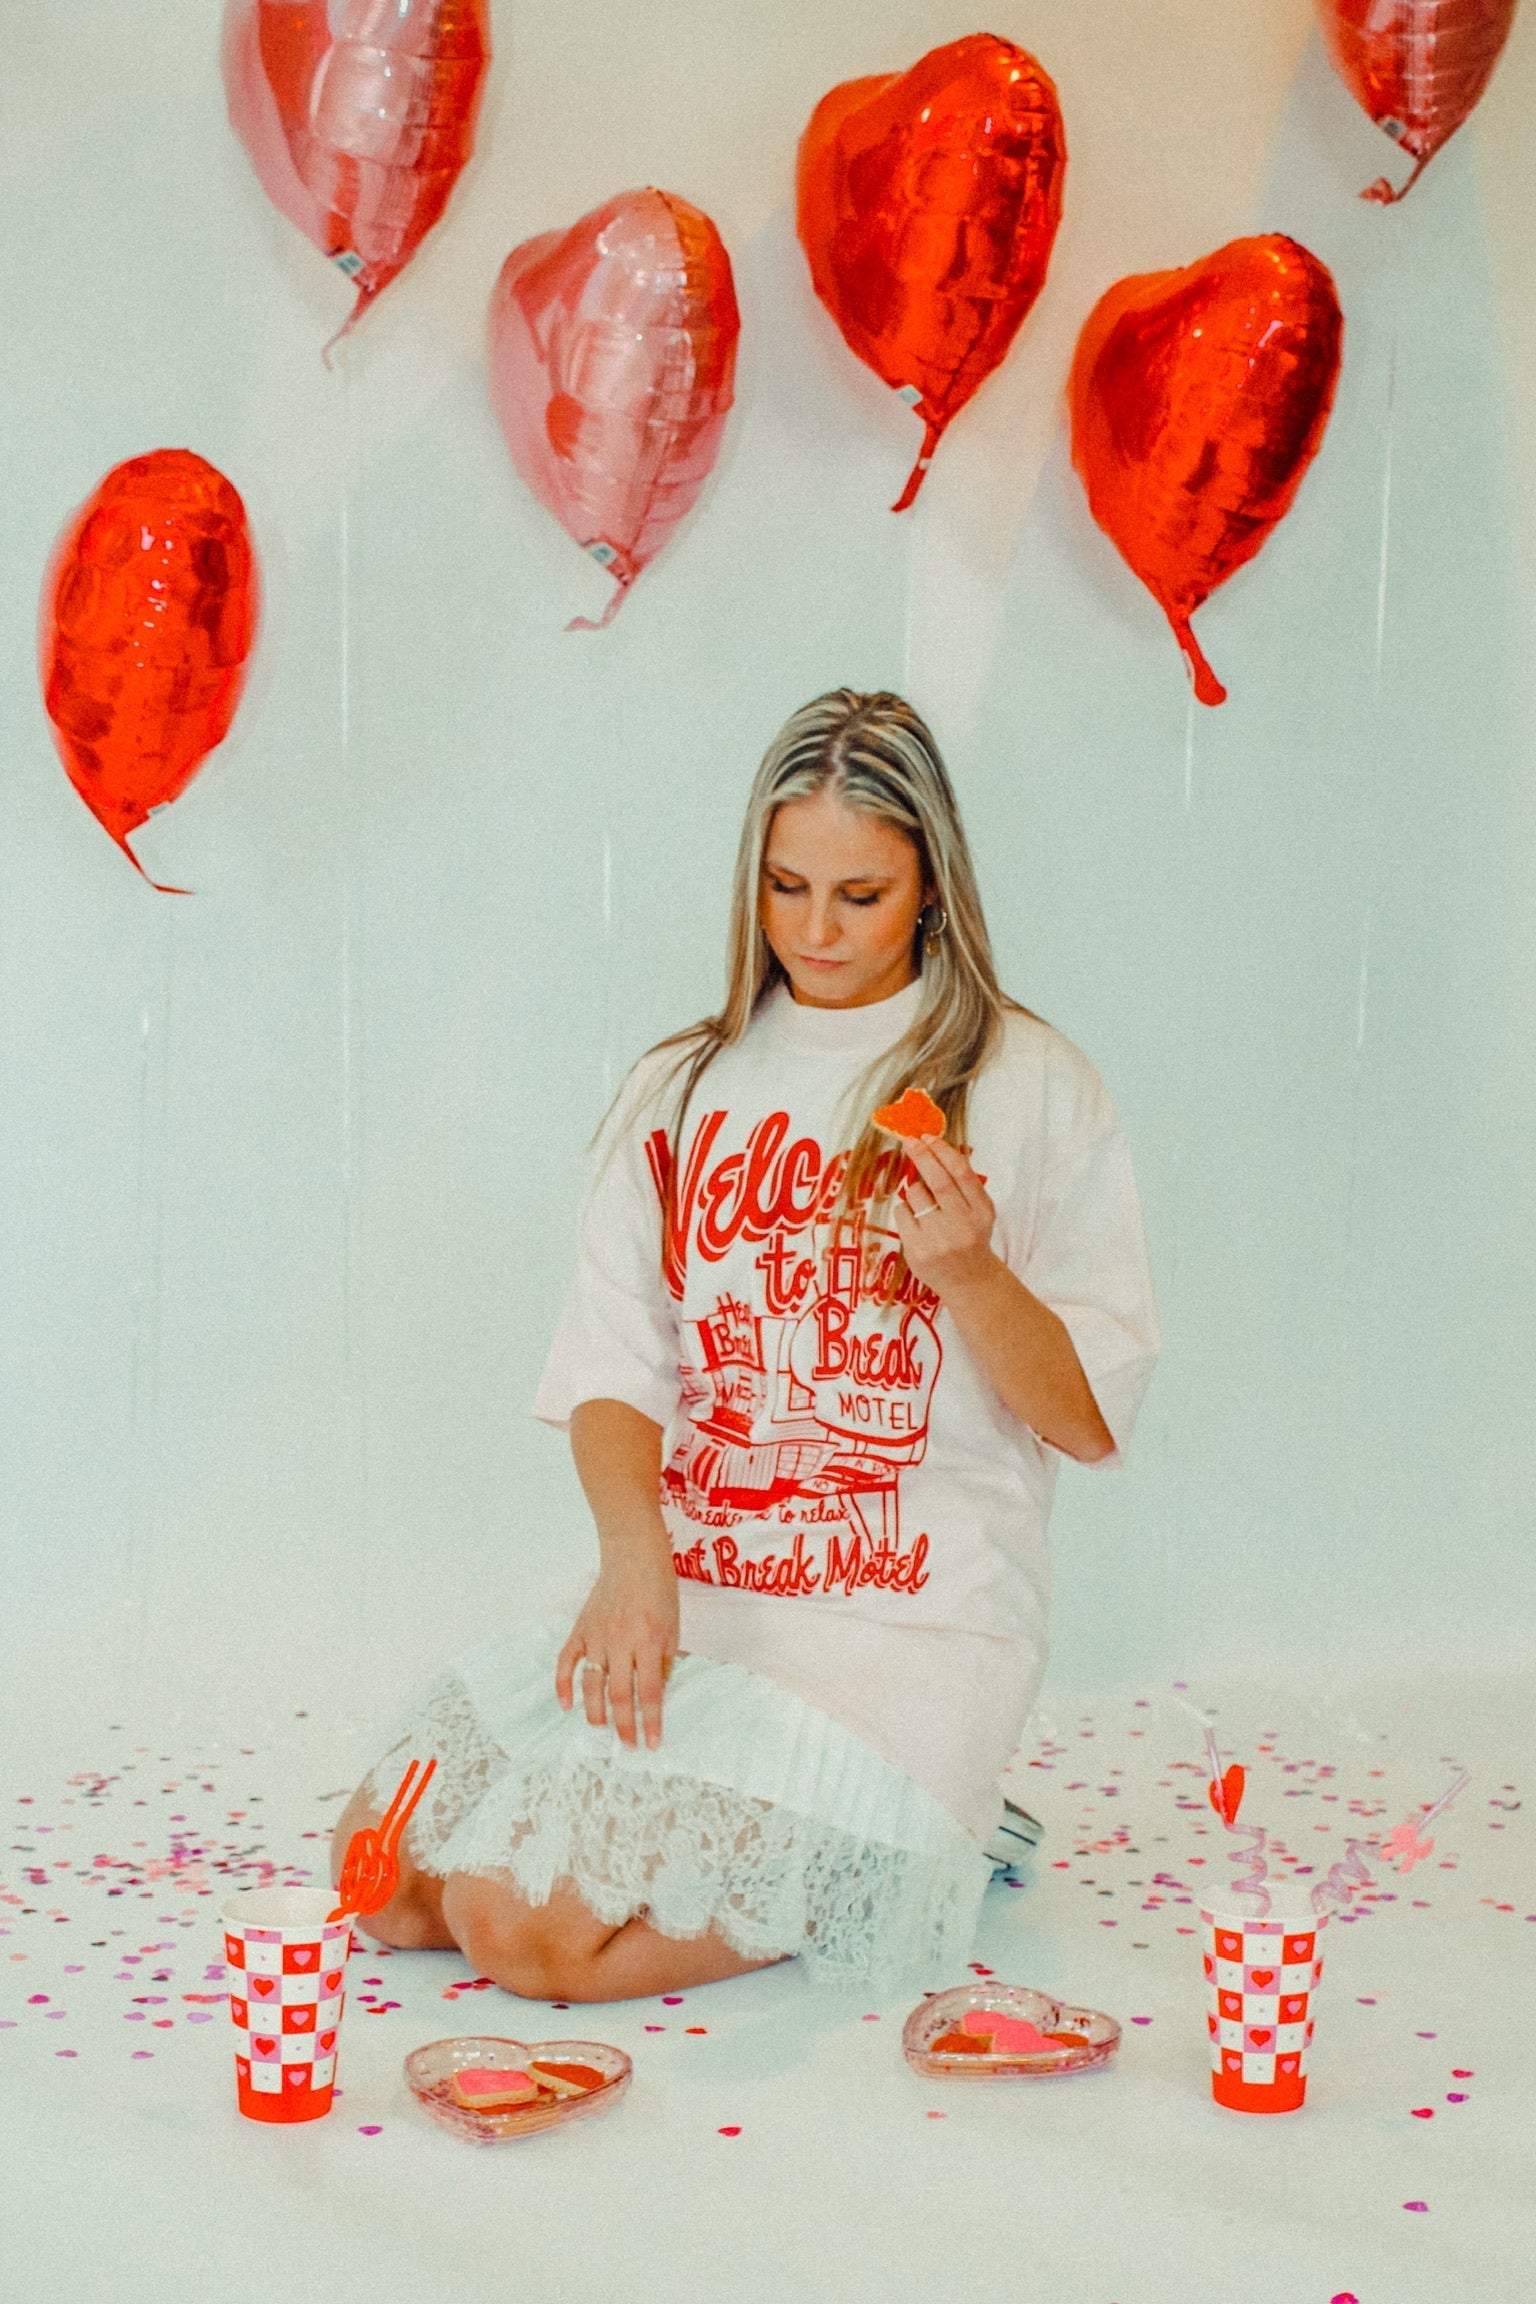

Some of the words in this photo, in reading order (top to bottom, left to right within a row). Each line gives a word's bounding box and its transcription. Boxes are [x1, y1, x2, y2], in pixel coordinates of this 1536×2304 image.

[756, 1230, 817, 1315] to
[812, 1296, 922, 1390] Break
[838, 1391, 918, 1430] MOTEL
[778, 1502, 795, 1524] to
[800, 1500, 850, 1524] relax
[712, 1533, 822, 1597] Break
[823, 1532, 929, 1597] Motel
